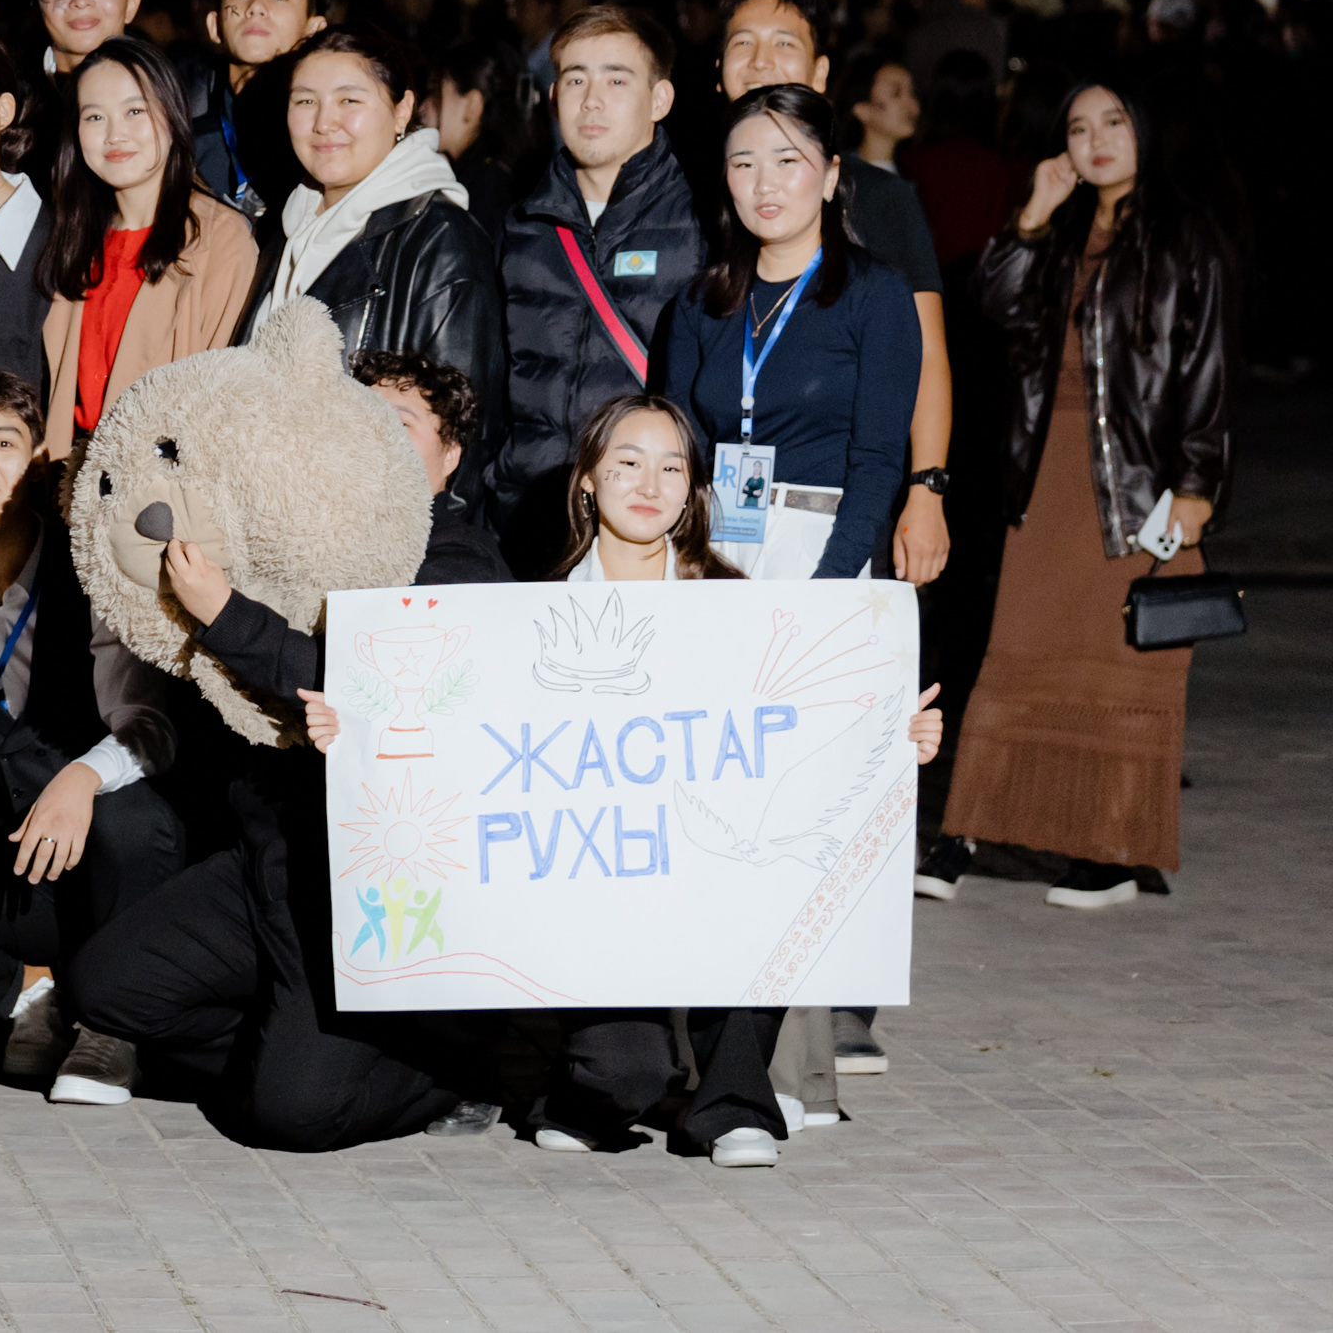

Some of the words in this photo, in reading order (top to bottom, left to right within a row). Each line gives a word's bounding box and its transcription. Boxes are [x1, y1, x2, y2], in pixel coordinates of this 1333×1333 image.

[605, 470, 621, 481] JR
[713, 450, 737, 488] JR
[480, 705, 798, 795] ЖАСТАР
[477, 804, 670, 883] РУХЫ
